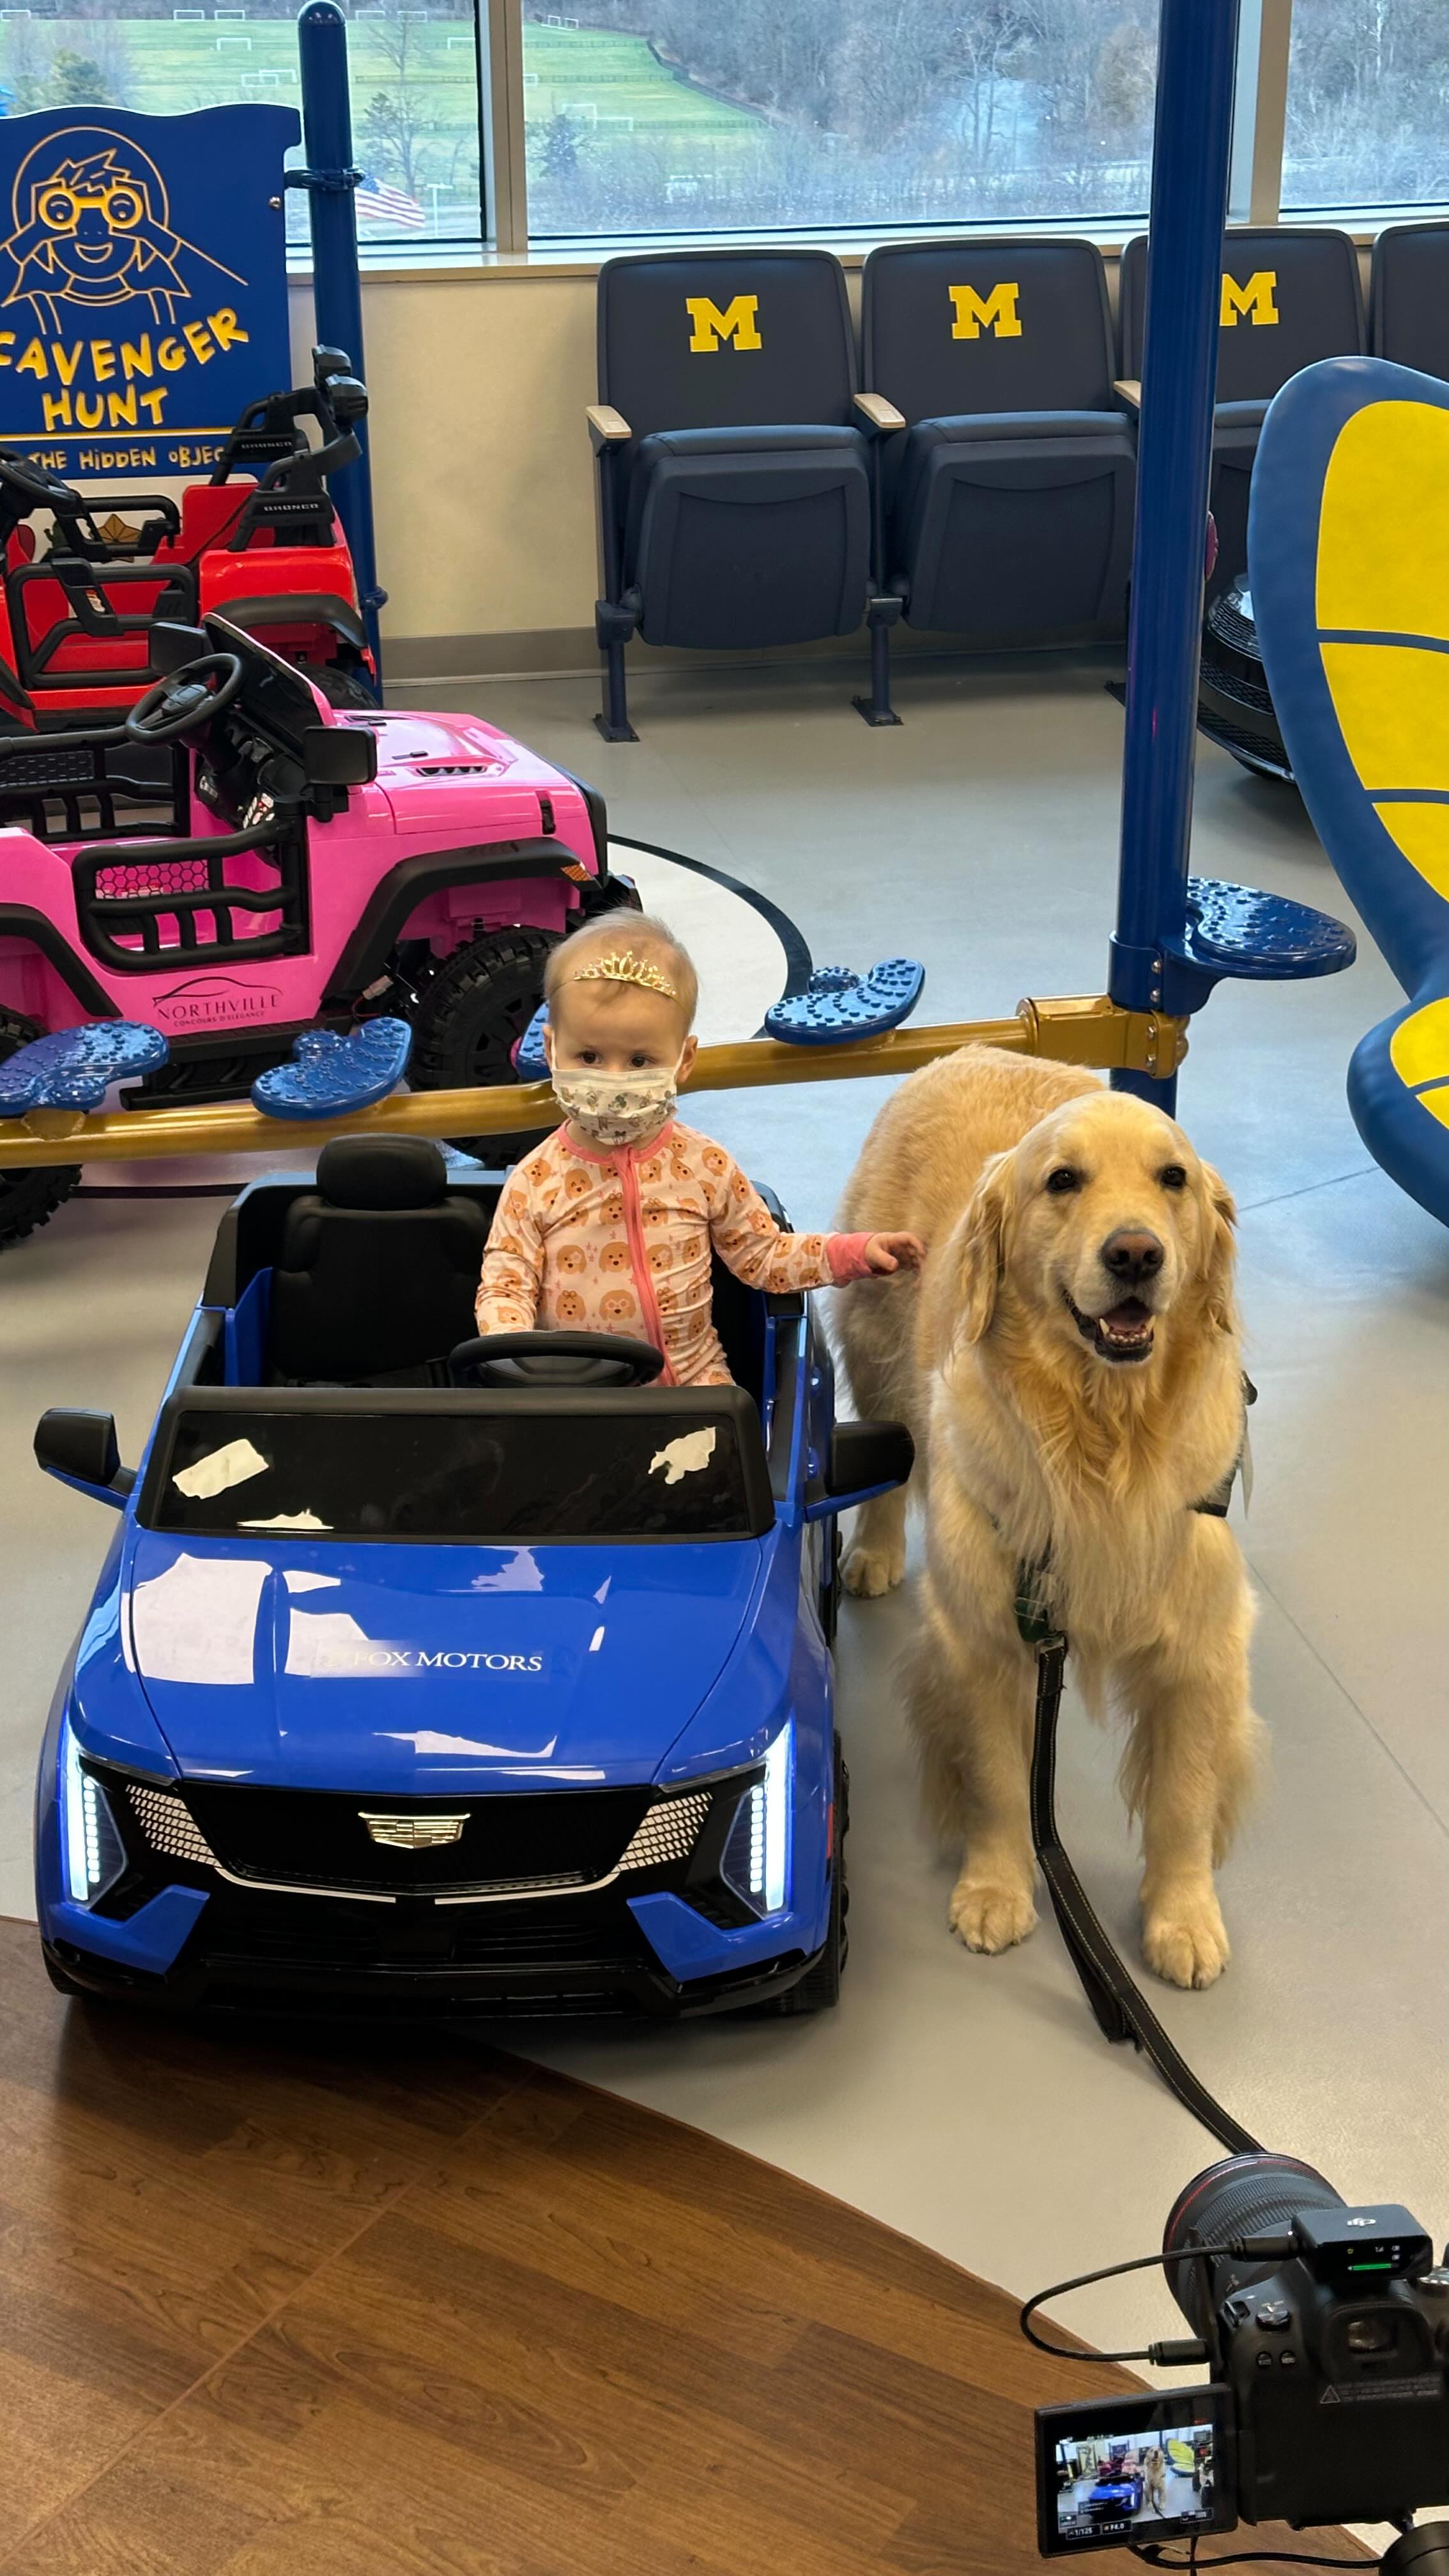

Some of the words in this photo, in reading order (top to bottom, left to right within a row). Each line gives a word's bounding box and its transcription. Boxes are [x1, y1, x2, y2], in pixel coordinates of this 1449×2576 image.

[948, 282, 1022, 339] M
[1219, 271, 1279, 326] M
[686, 295, 762, 352] M
[42, 384, 169, 432] HUNT
[27, 450, 67, 470] THE
[263, 503, 319, 512] BRONCO
[158, 994, 278, 1020] NORTHVILLE
[416, 1652, 542, 1671] MOTORS
